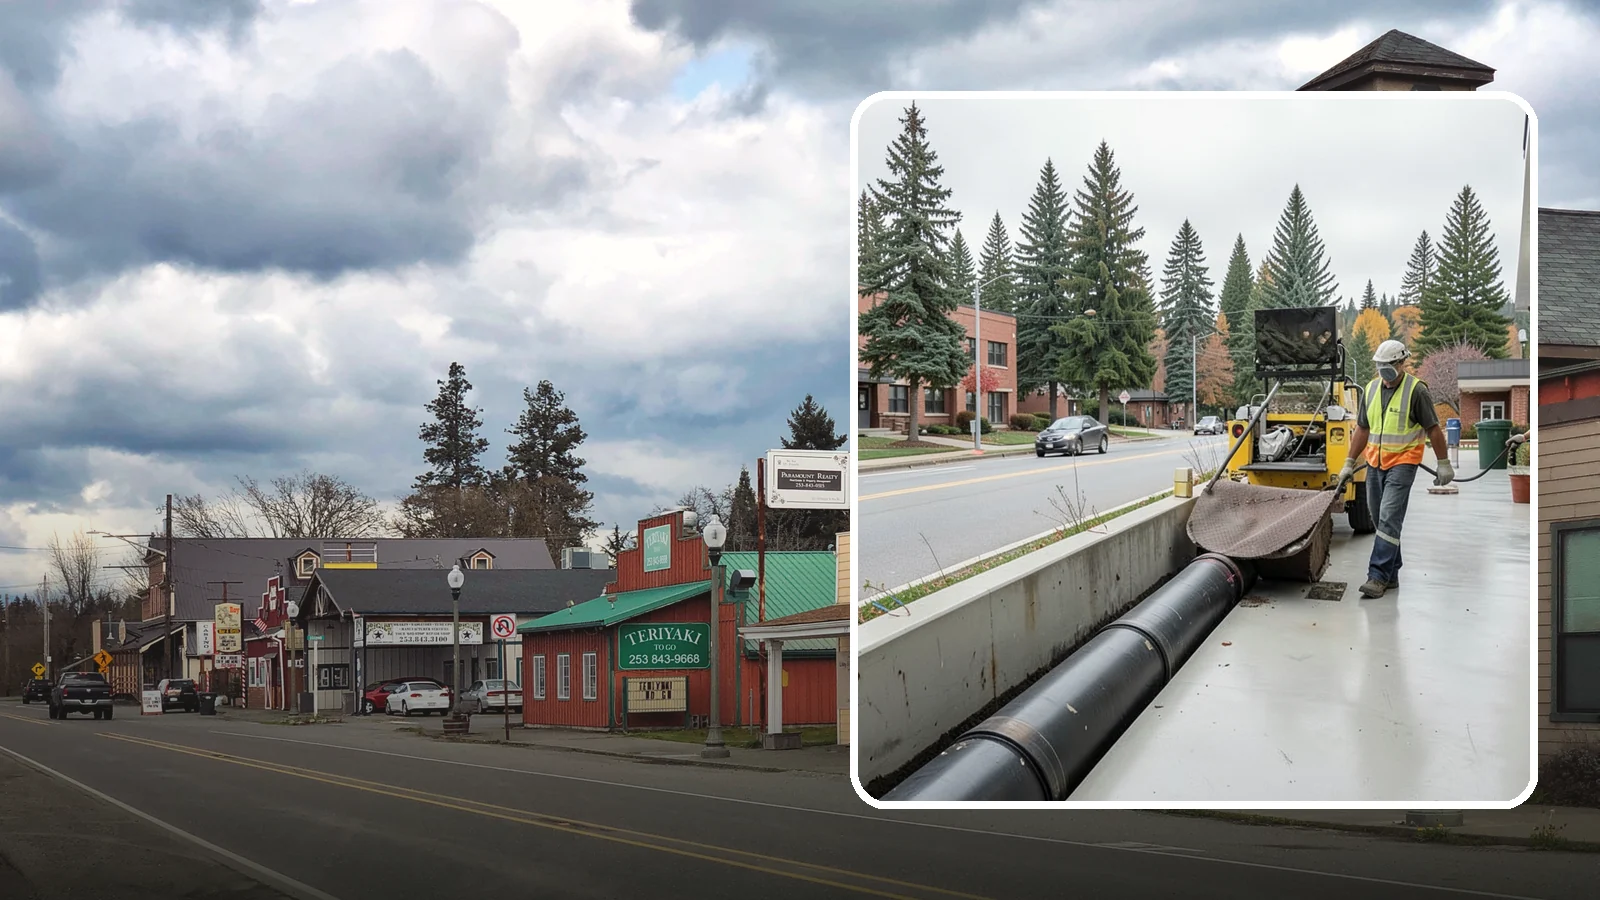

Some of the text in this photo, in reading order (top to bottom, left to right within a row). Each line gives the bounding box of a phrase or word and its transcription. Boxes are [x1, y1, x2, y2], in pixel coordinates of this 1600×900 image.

[781, 471, 838, 480] PARAMOUNT REALTY
[646, 531, 668, 549] TERIYAKI
[625, 627, 702, 646] TERIYAKI
[629, 654, 700, 665] 253 843-9668
[639, 681, 672, 691] TERIYAKI
